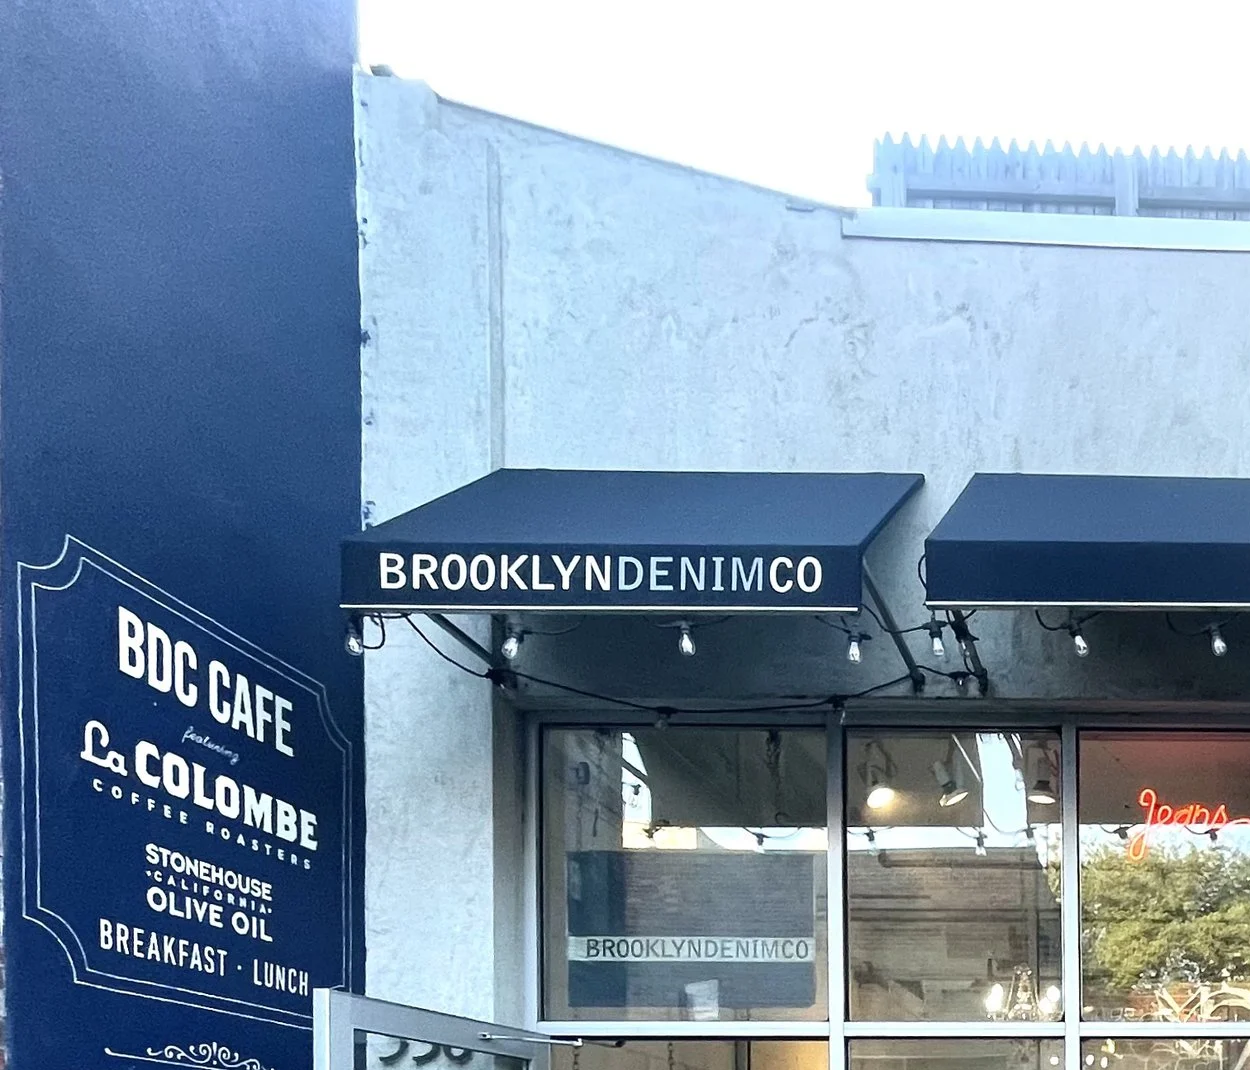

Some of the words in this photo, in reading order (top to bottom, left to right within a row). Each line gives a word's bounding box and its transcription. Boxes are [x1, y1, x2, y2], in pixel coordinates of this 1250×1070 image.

[379, 552, 823, 593] BROOKLYNDENIMCO
[118, 605, 199, 708] BDC
[208, 659, 295, 758] CAFE
[181, 725, 241, 766] featuring
[80, 719, 129, 777] La
[135, 740, 319, 851] COLOMBE
[92, 777, 189, 825] COFFEE
[205, 820, 312, 870] ROASTERS
[145, 842, 273, 901] STONEHOUSE
[146, 886, 224, 929] OLIVE
[231, 911, 274, 943] OIL
[99, 918, 228, 977] BREAKFAST
[253, 958, 309, 997] LUNCH
[585, 938, 809, 960] BROOKLYNDENIMCO
